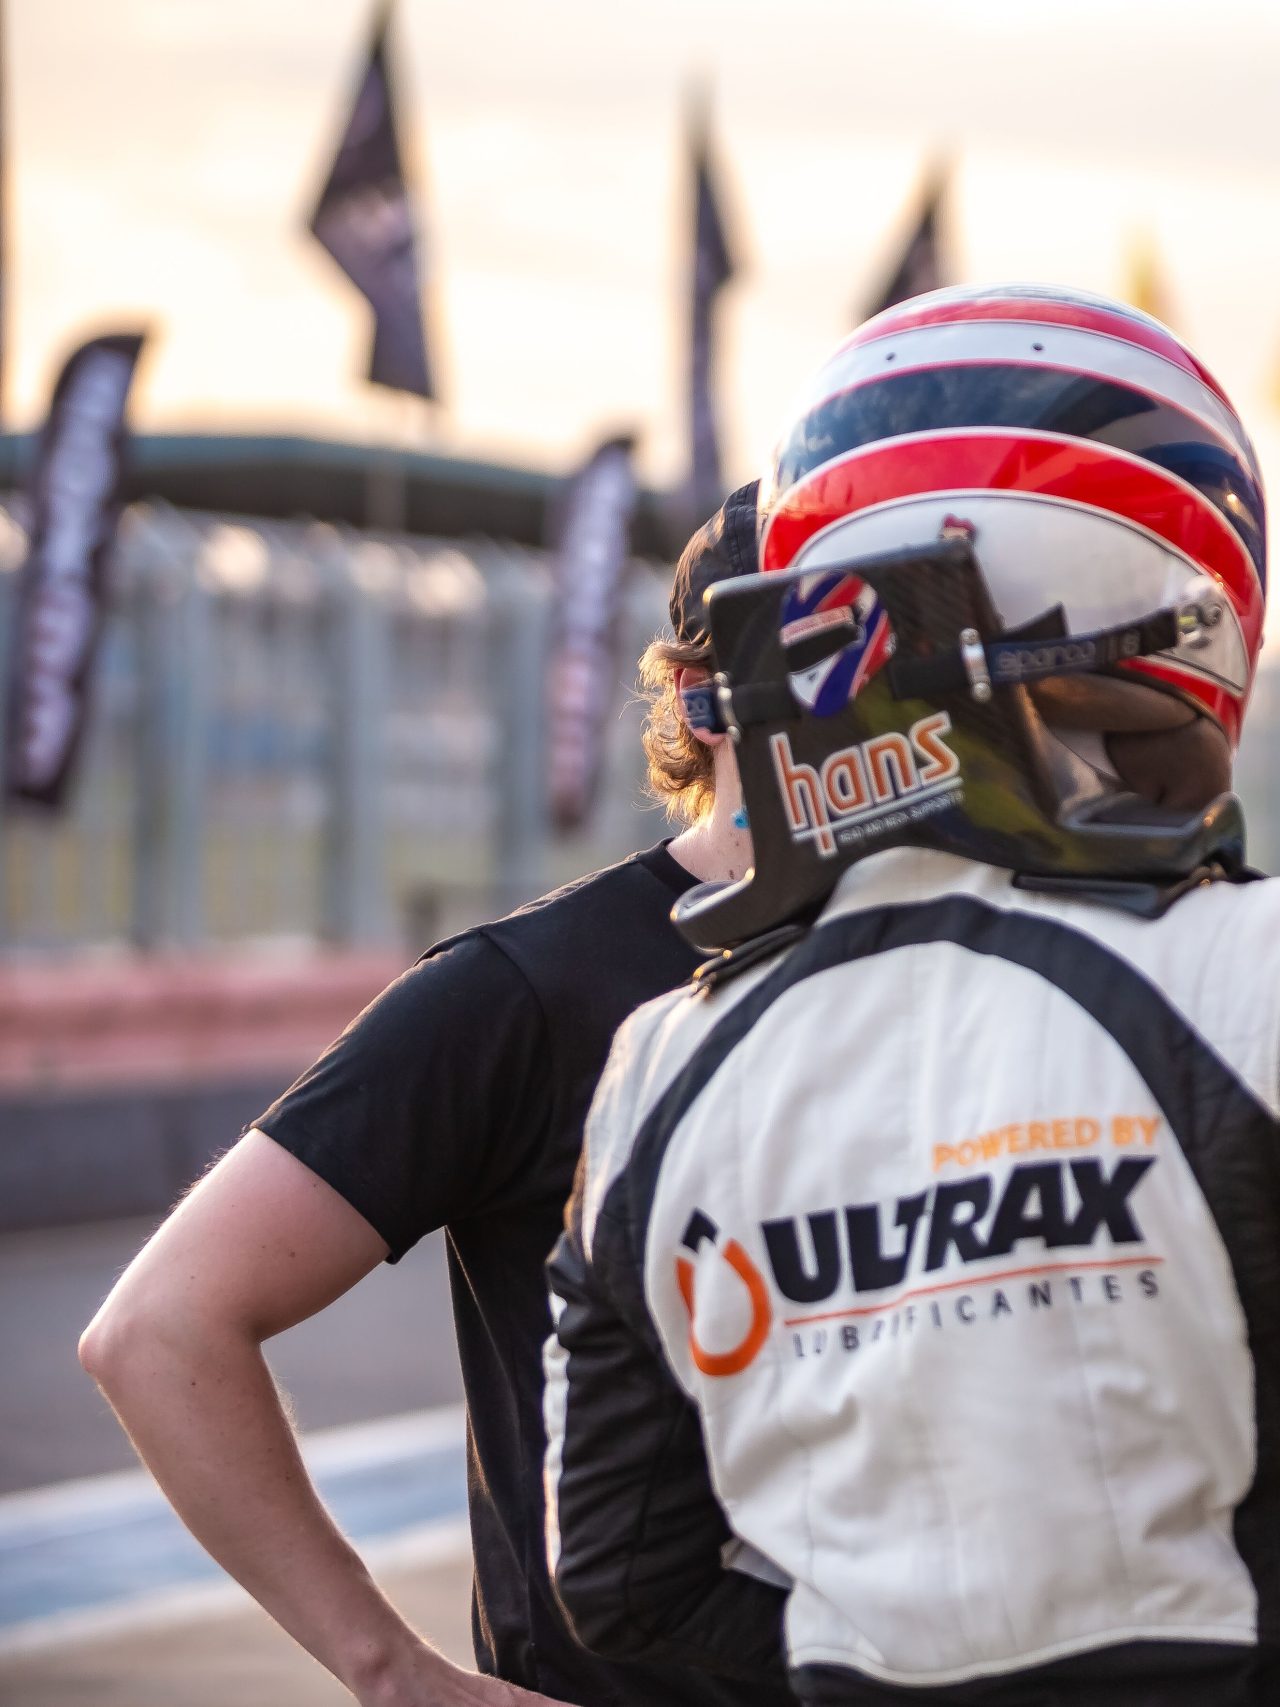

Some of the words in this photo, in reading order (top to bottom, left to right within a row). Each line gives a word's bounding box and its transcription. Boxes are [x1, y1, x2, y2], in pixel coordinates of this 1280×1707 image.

[769, 710, 961, 858] hans
[932, 1117, 1101, 1172] POWERED
[1112, 1114, 1162, 1148] BY
[760, 1154, 1159, 1304] ULTRAX
